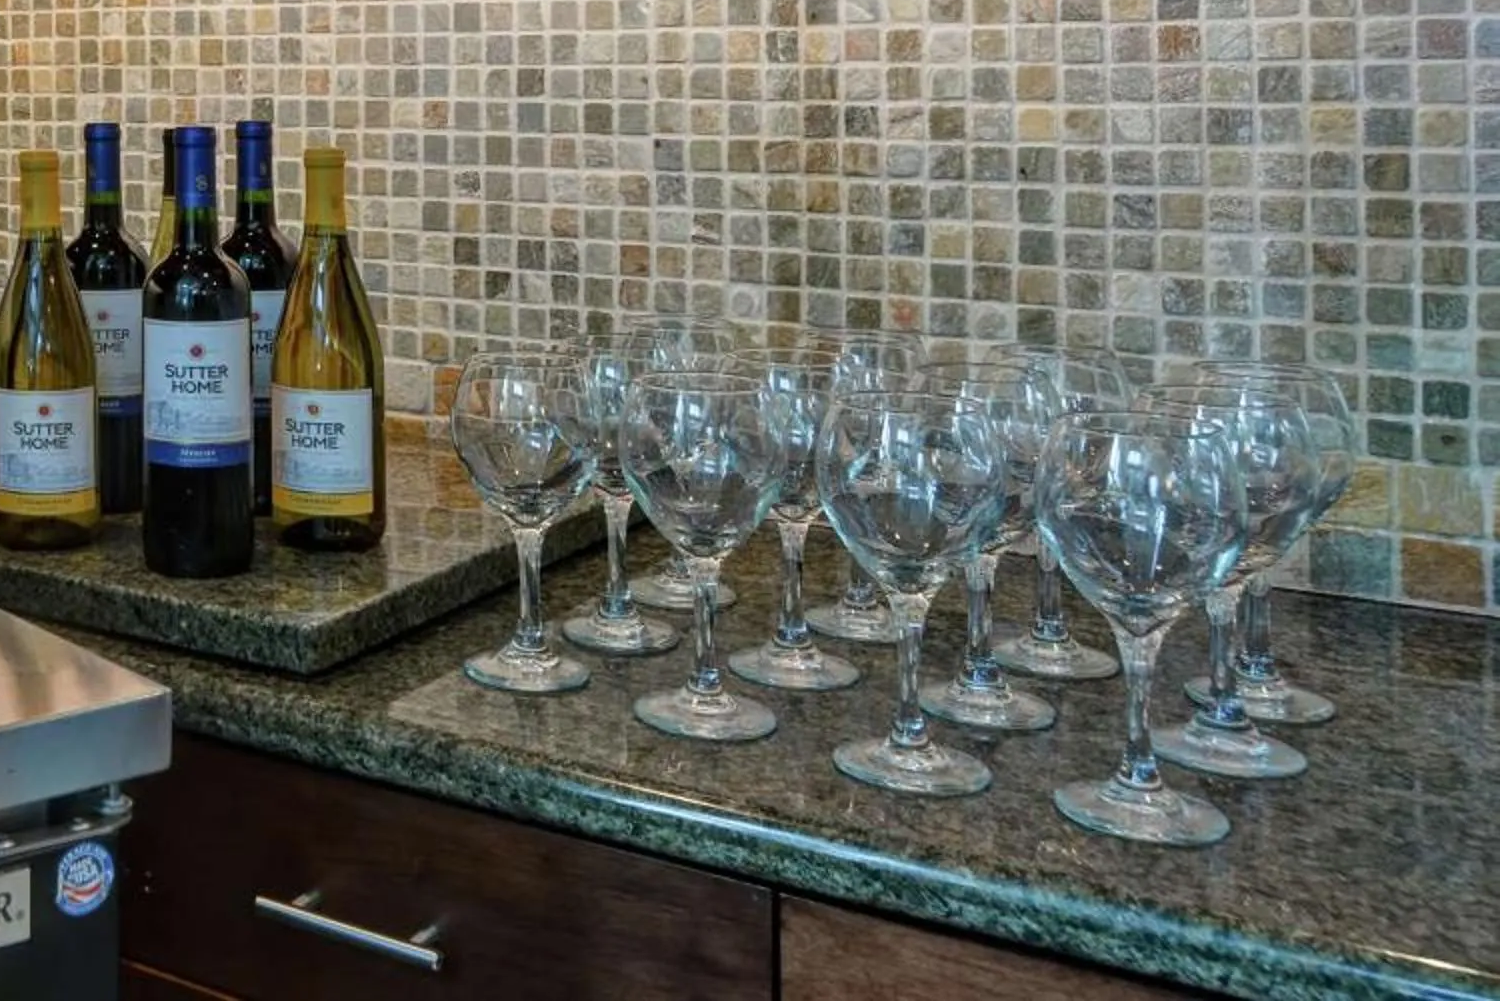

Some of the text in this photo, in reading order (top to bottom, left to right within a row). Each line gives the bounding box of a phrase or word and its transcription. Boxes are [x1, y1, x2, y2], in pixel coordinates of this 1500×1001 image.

[93, 328, 131, 340] TTER
[95, 342, 124, 353] OME
[165, 363, 229, 379] SUTTER
[171, 380, 223, 394] HOME
[13, 421, 76, 436] SUTTER
[285, 418, 345, 436] SUTTER
[20, 437, 69, 449] HOME
[291, 435, 340, 450] HOME
